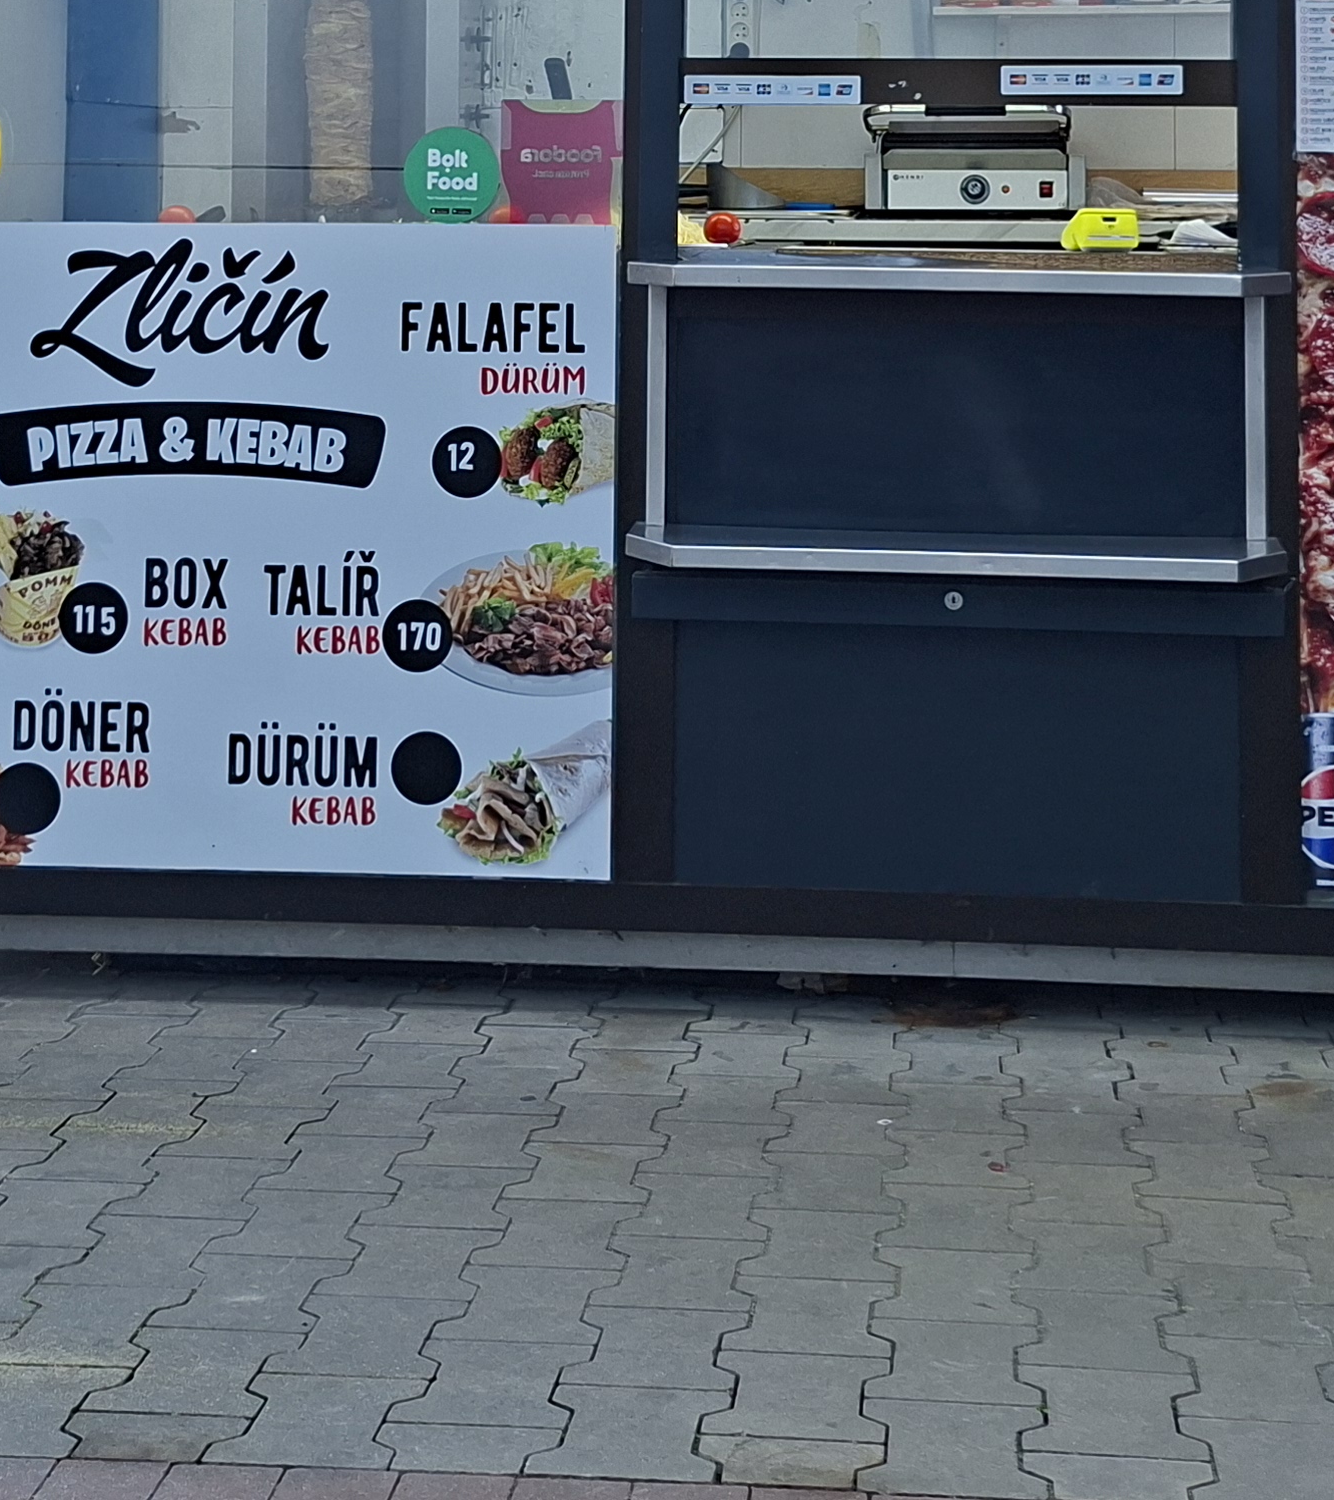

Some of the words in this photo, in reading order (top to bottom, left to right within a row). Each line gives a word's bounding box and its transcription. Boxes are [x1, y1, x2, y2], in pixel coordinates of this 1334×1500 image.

[428, 148, 468, 168] Bolt
[427, 172, 478, 191] Food
[30, 238, 329, 387] Zličín
[401, 302, 587, 355] FALAFEL
[480, 364, 587, 397] DÜRÜM
[27, 418, 146, 473] PIZZA
[158, 417, 196, 462] &
[207, 417, 346, 474] KEBAB
[144, 556, 228, 610] BOX
[265, 549, 380, 617] TALÍŘ
[73, 604, 116, 637] 115
[143, 617, 227, 648] KEBAB
[397, 621, 442, 653] 170
[295, 624, 381, 656] KEBAB
[13, 688, 151, 755] DÖNER
[228, 723, 378, 790] DÜRÜM
[65, 759, 150, 790] KEBAB
[291, 797, 376, 828] KEBAB
